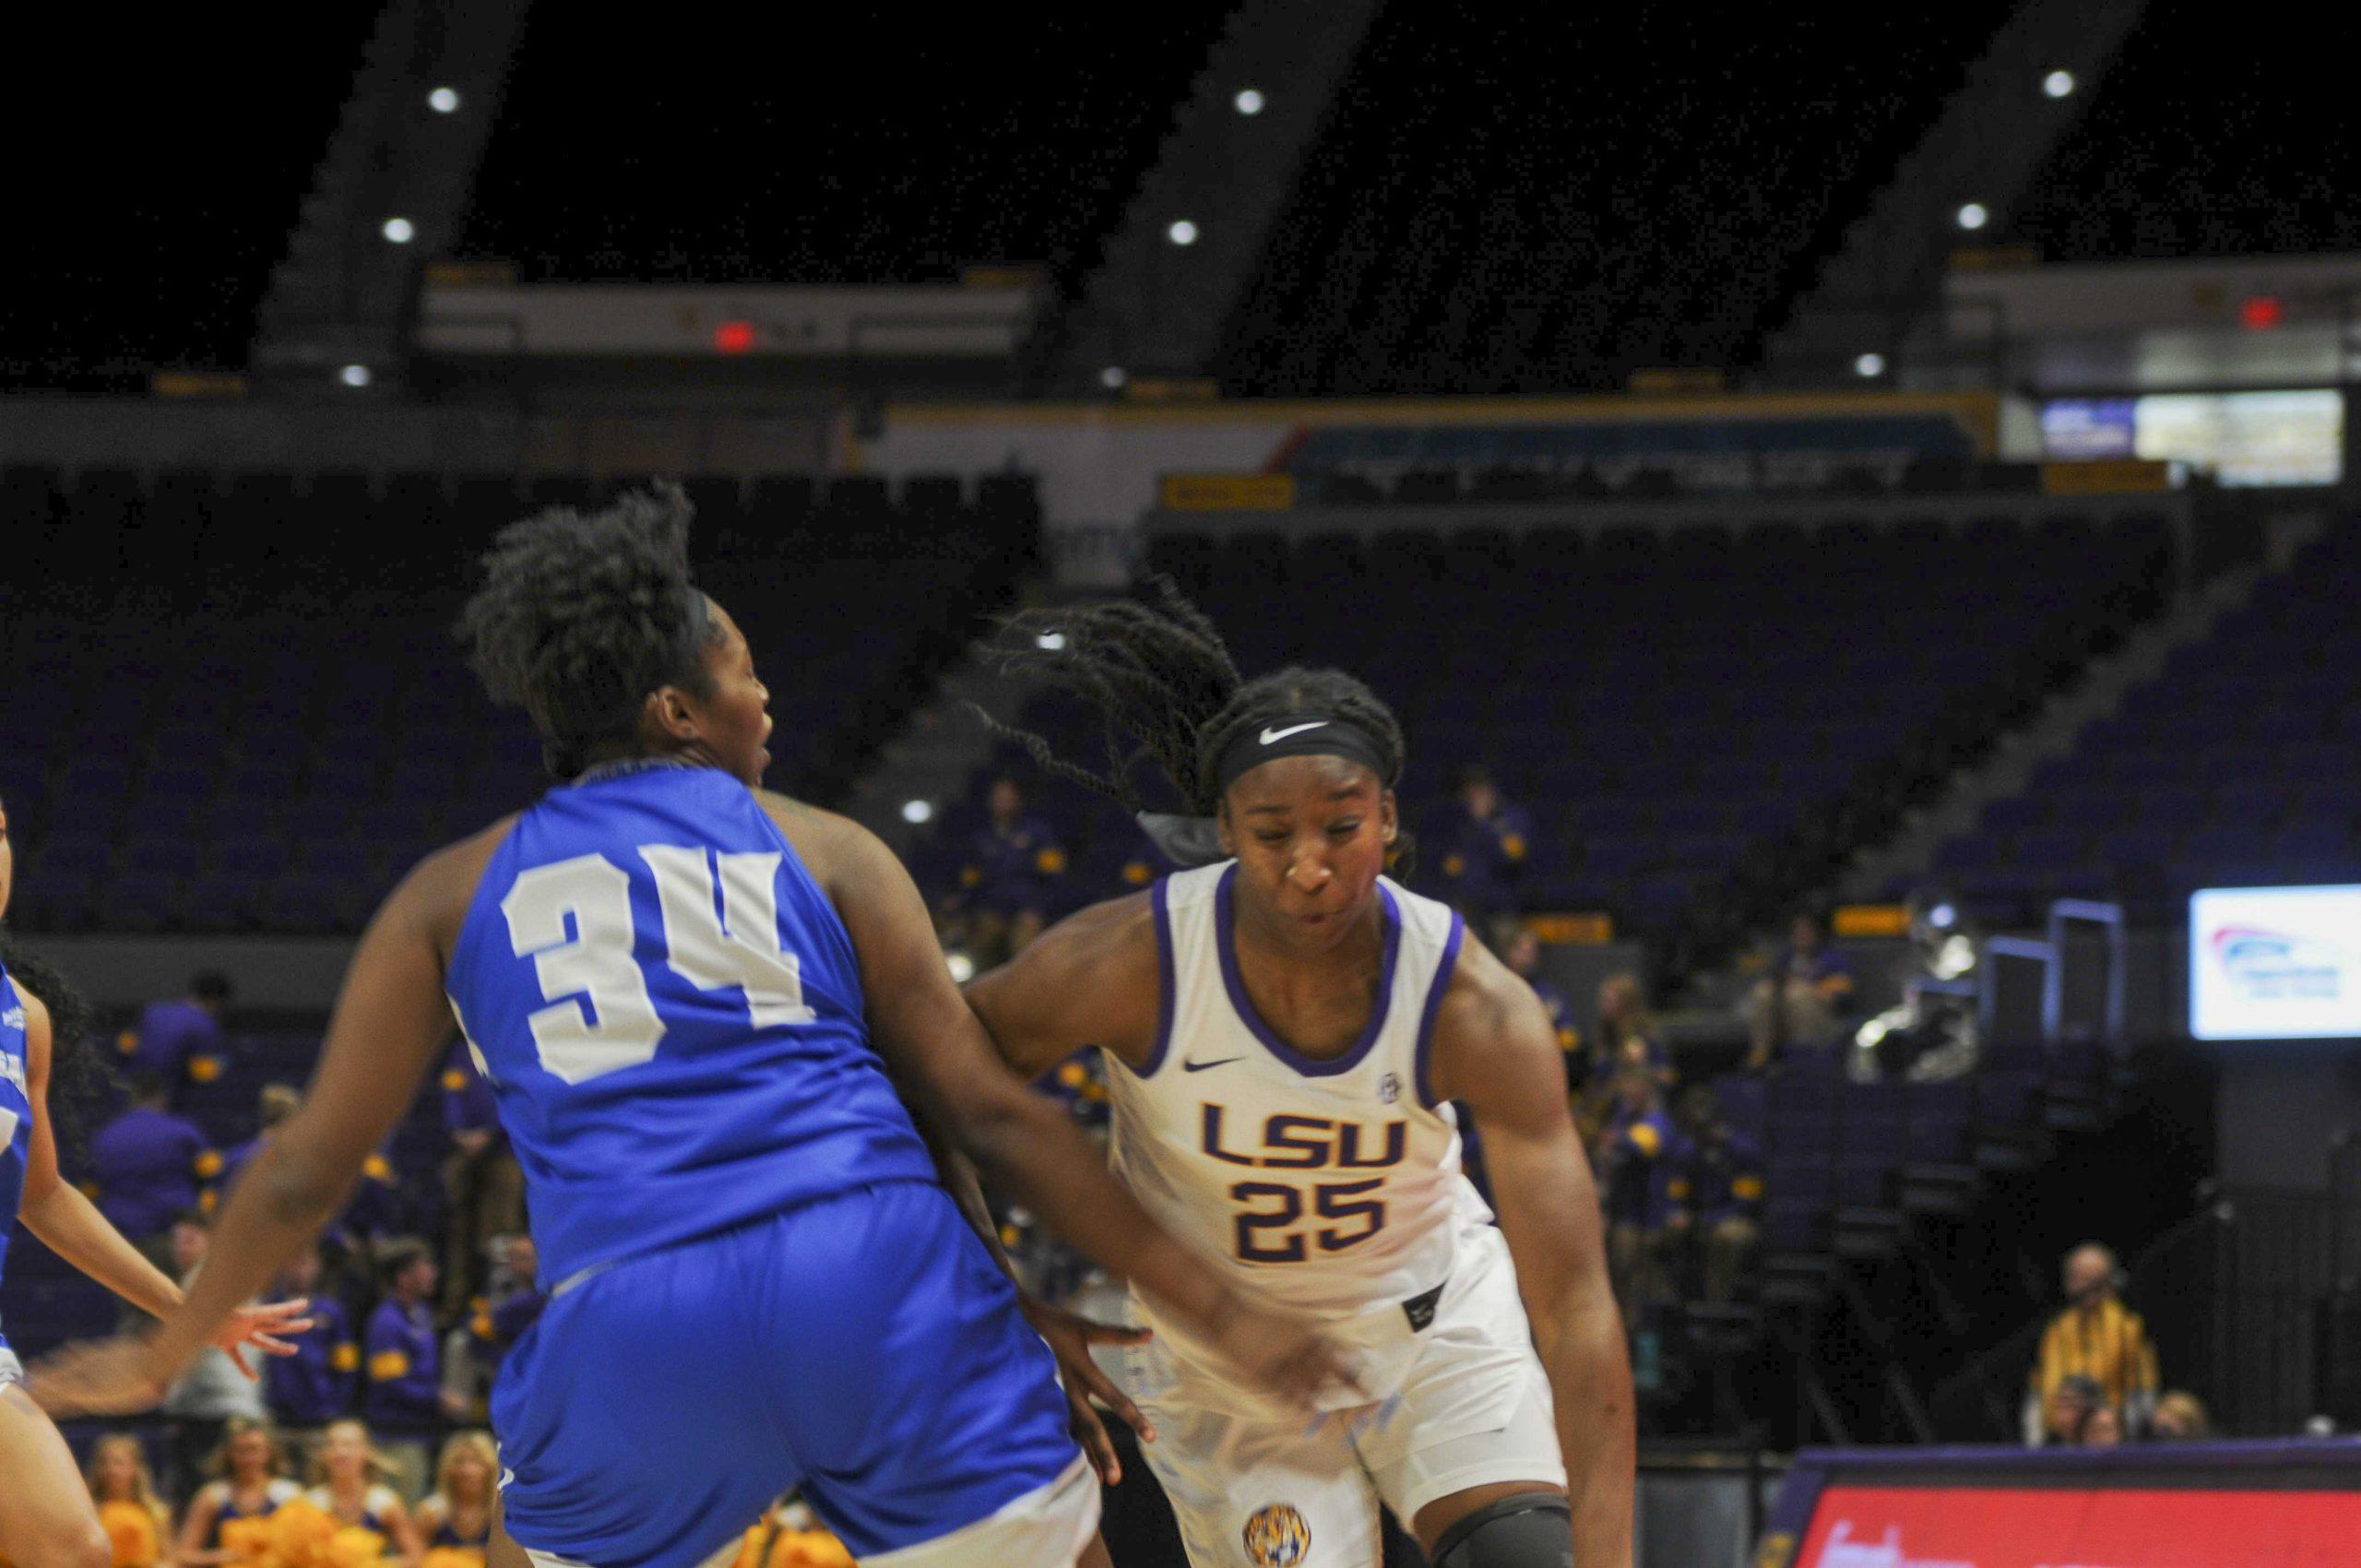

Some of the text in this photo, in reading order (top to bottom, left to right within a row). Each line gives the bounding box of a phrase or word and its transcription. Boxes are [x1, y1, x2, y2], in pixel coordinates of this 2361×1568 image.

[500, 843, 817, 1086] 34
[1201, 1101, 1407, 1169] LSU
[1228, 1177, 1388, 1263] 25
